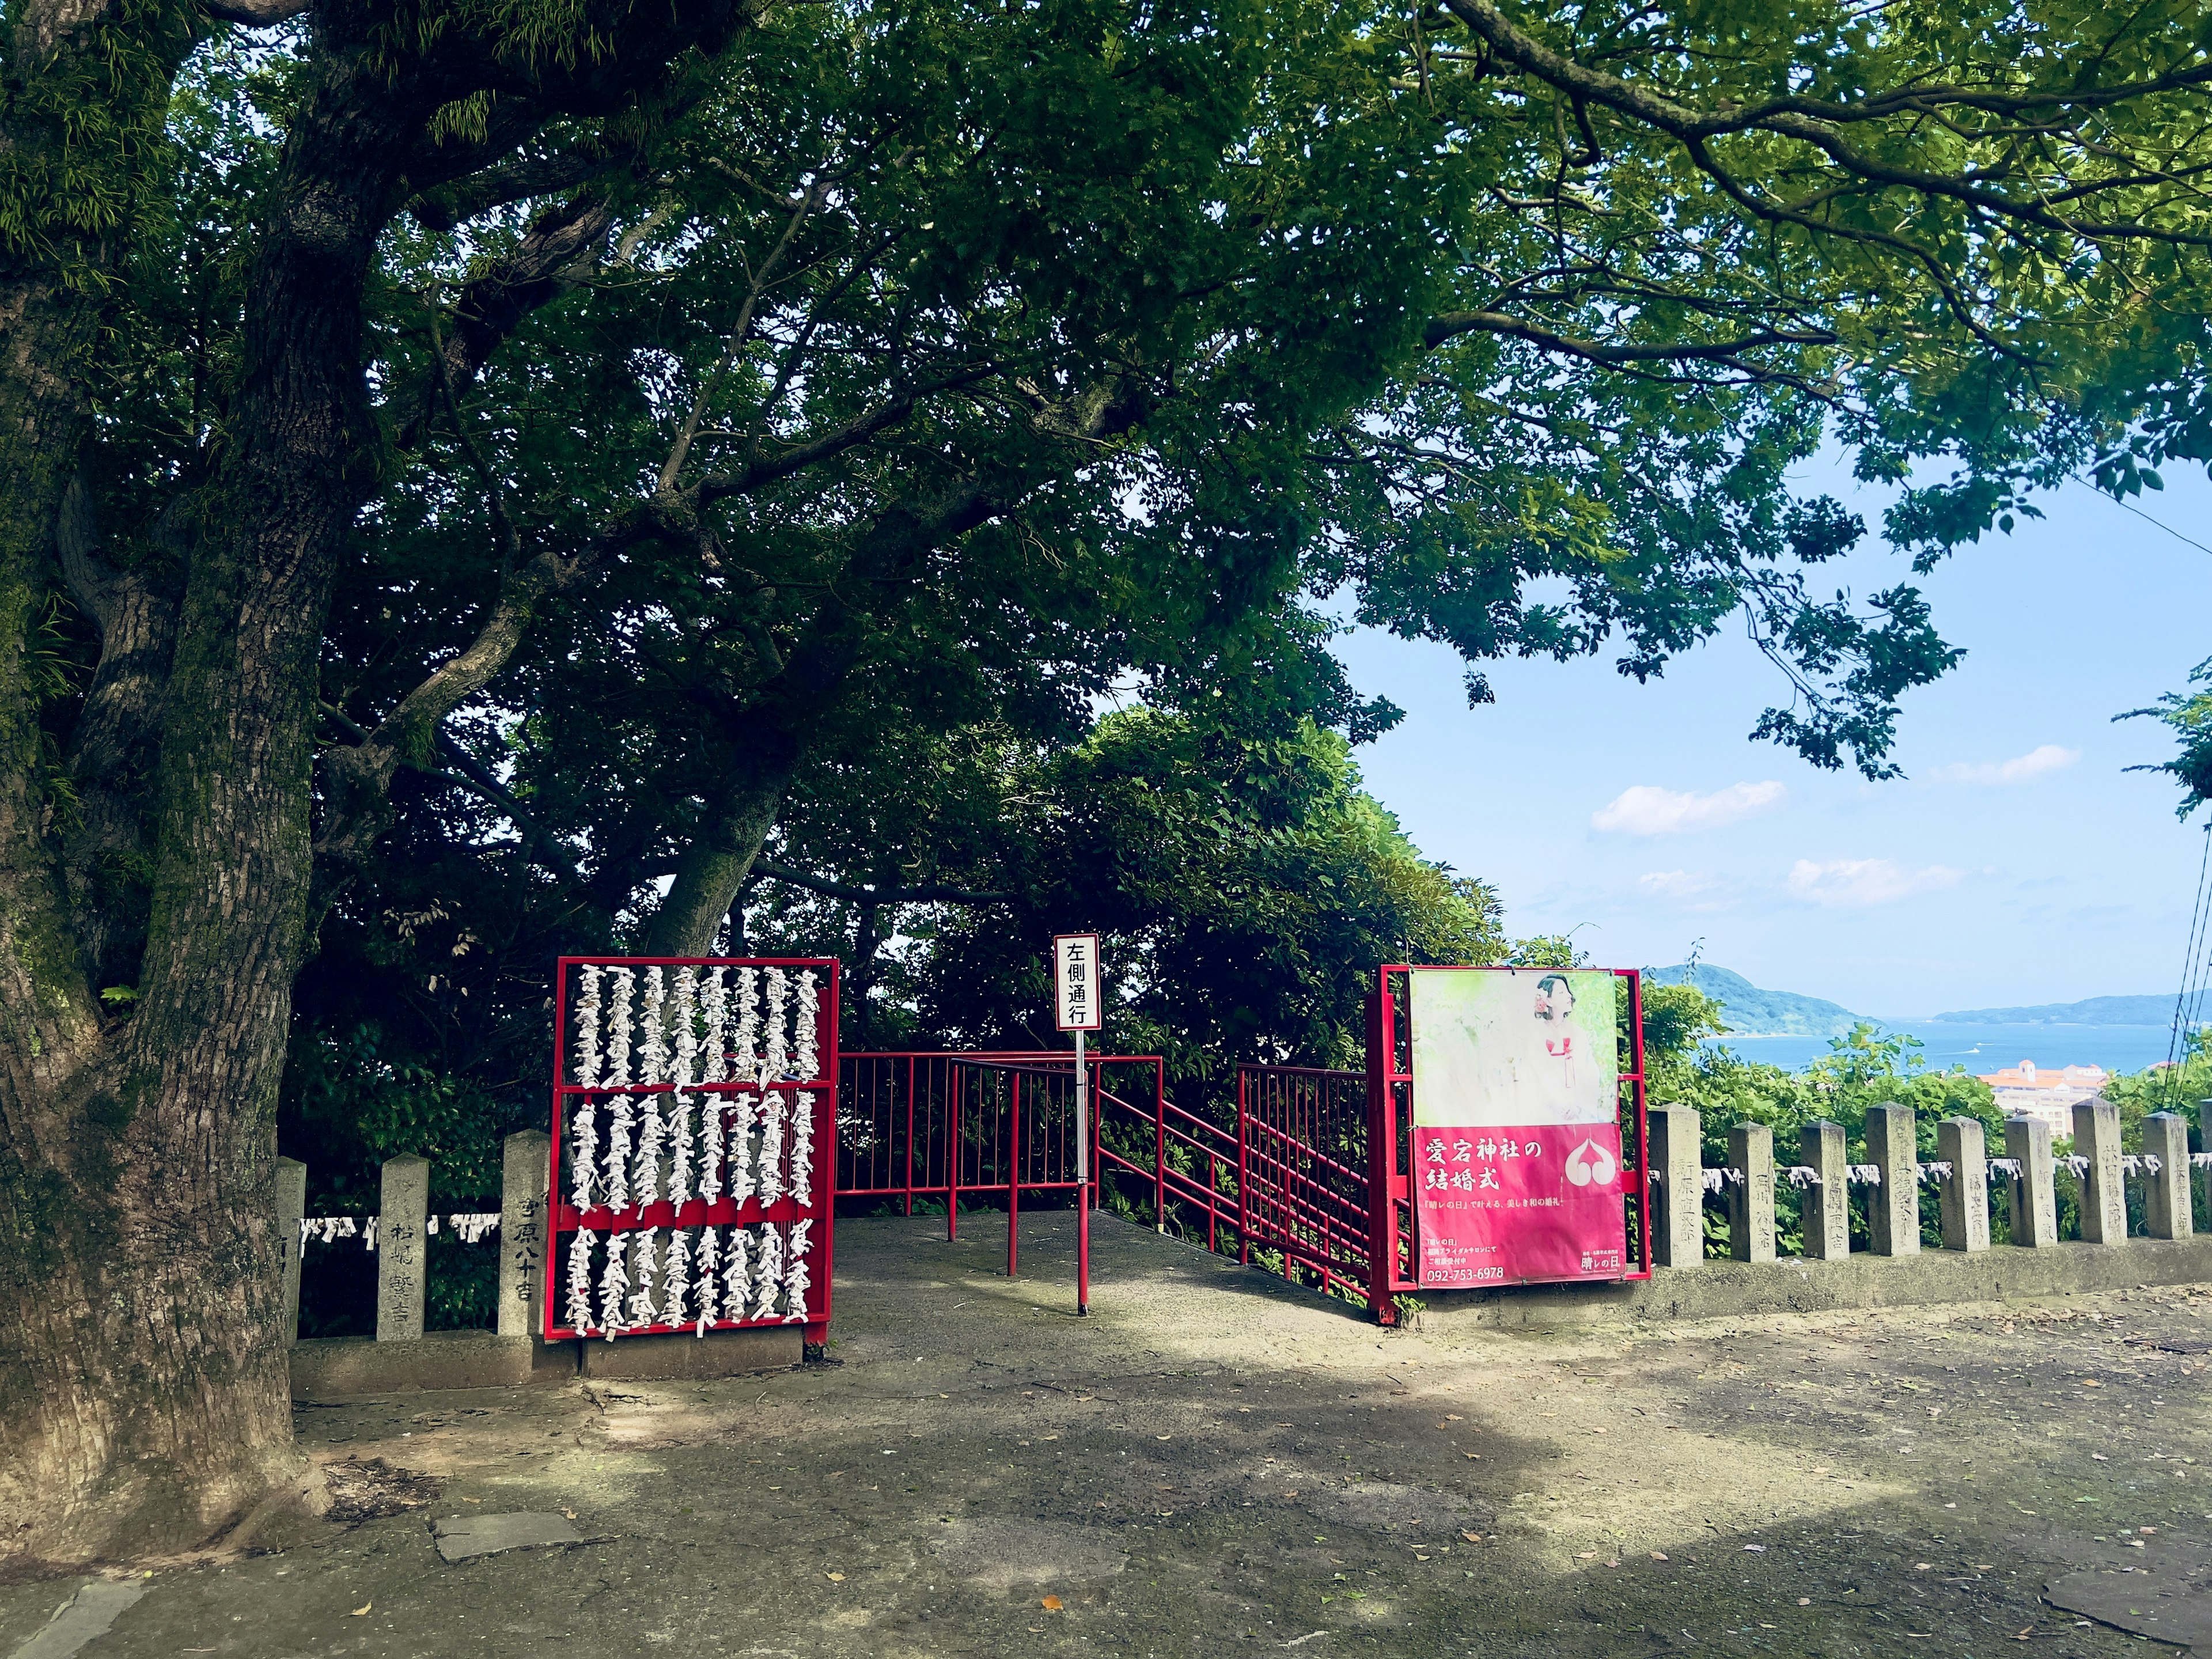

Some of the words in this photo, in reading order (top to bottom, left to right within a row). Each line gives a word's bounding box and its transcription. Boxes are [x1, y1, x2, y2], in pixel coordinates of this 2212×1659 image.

[1067, 942, 1086, 1024] 左側通行
[1425, 1137, 1541, 1165] 愛宕神社の
[1425, 1166, 1500, 1192] 結婚式
[1426, 1266, 1504, 1282] 092-753-6978
